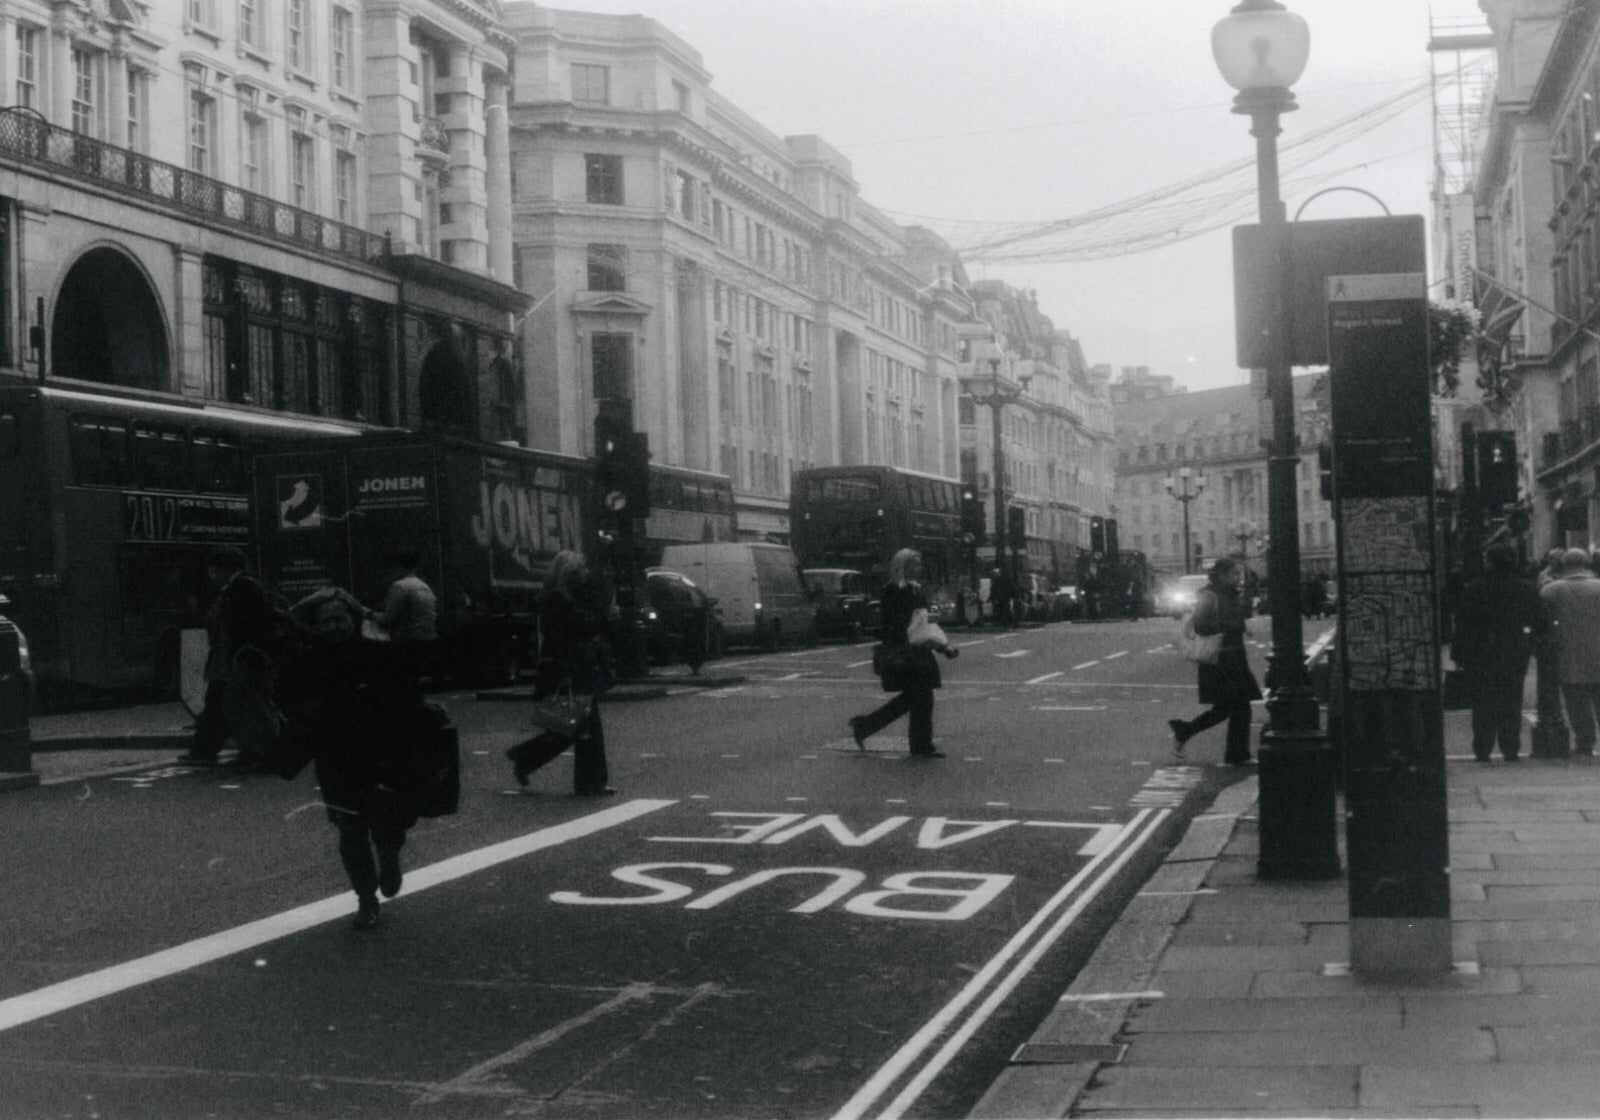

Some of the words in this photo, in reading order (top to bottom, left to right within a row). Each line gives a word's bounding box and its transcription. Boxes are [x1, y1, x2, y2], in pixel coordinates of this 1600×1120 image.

[127, 496, 176, 539] 2012
[644, 811, 1124, 856] LANE
[549, 862, 1016, 920] BUS
